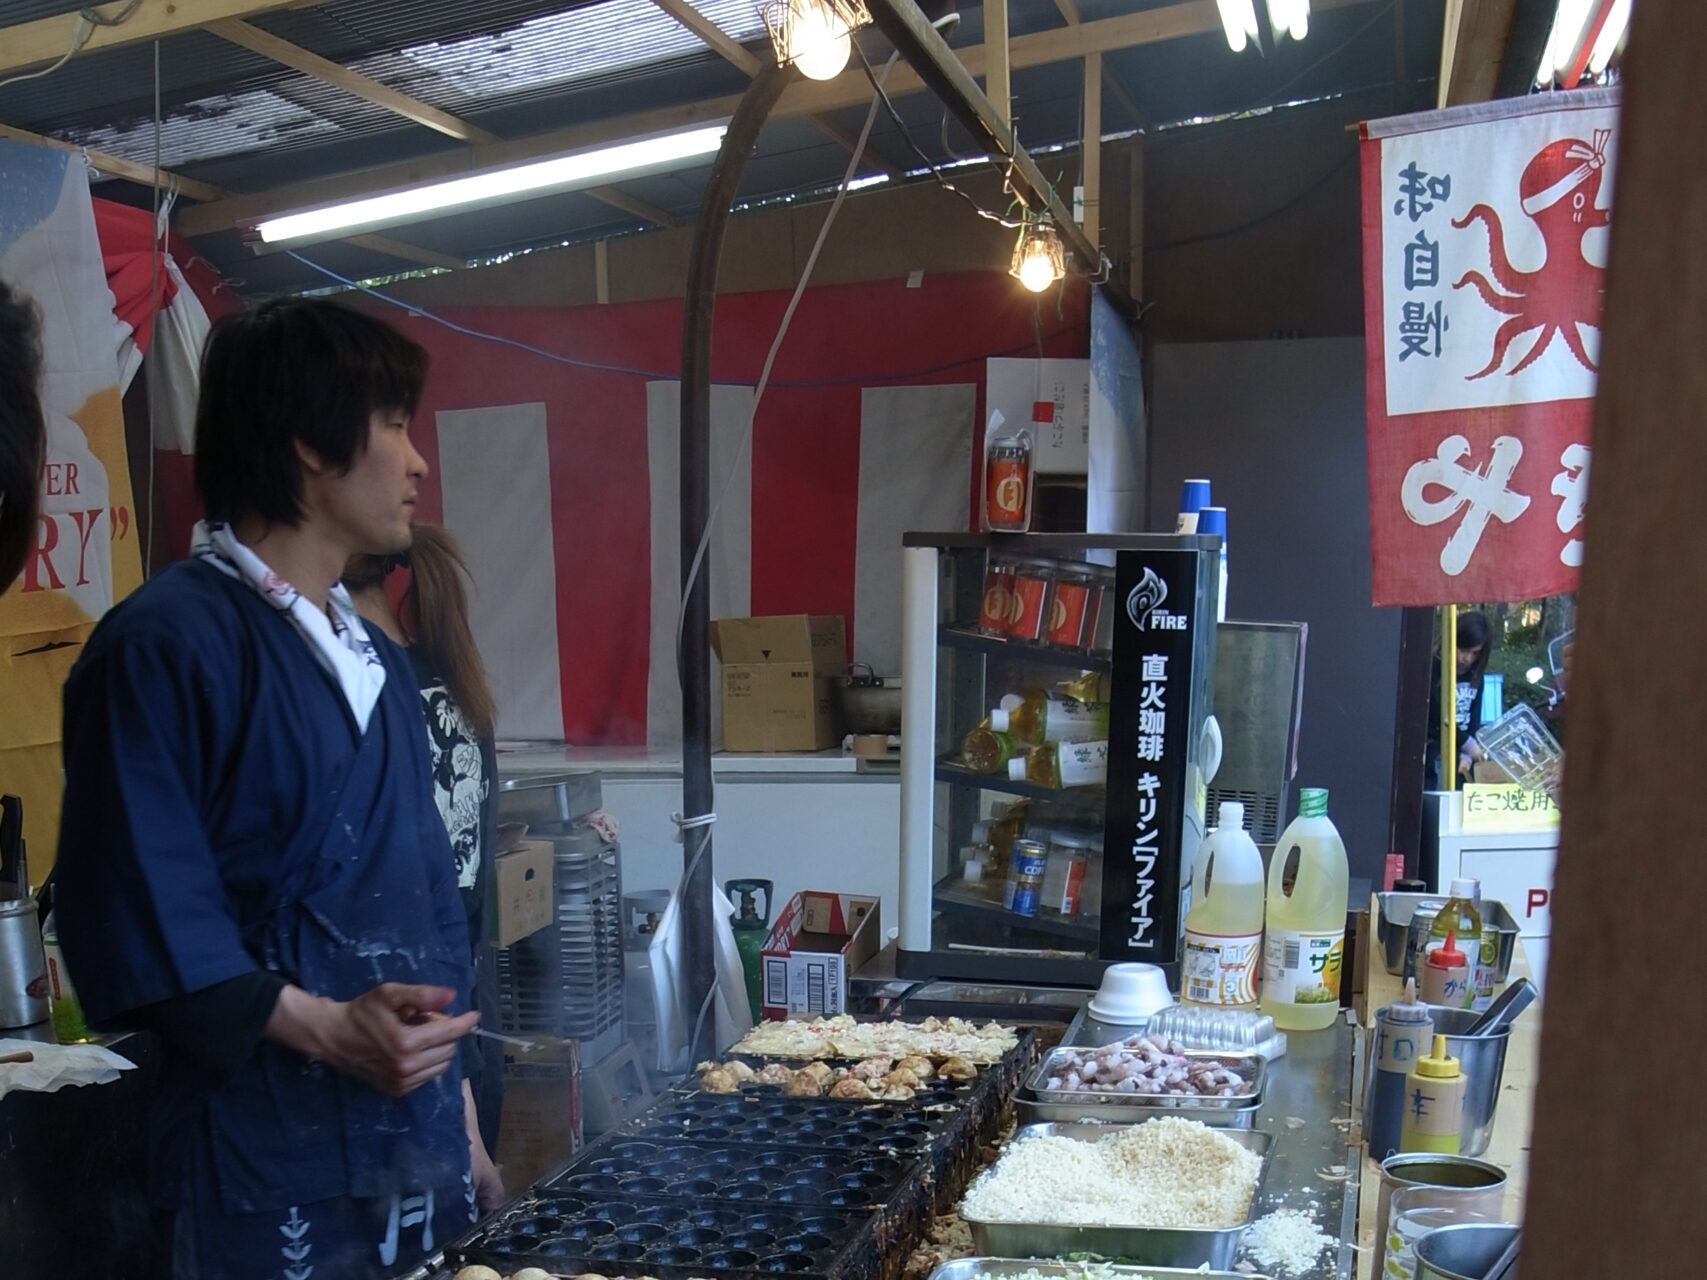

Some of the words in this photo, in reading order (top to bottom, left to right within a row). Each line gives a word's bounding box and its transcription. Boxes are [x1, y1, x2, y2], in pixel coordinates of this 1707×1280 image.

[46, 463, 80, 496] ER
[1151, 615, 1187, 630] FIRE
[1137, 654, 1169, 762] 直火珈琲
